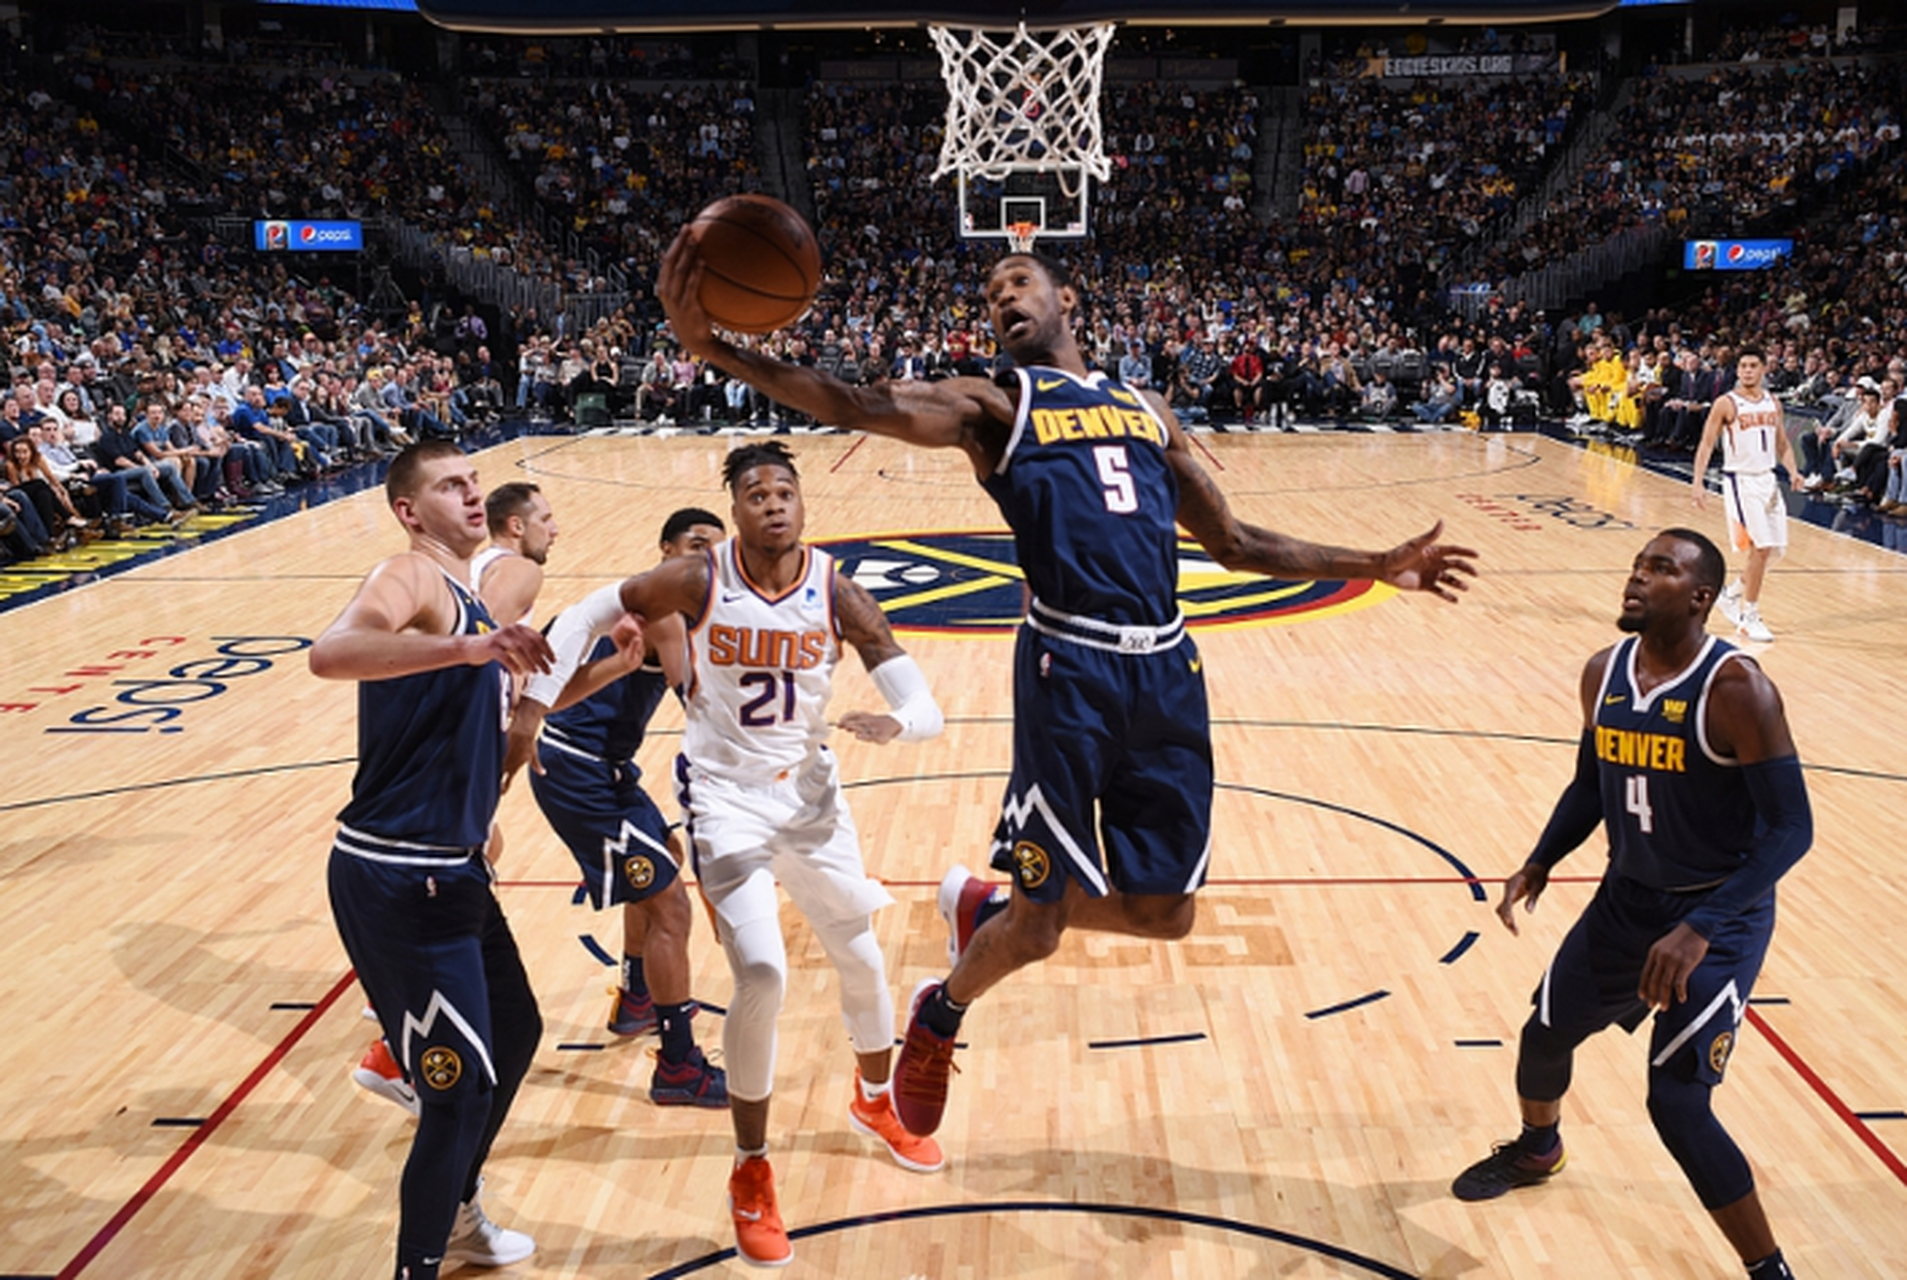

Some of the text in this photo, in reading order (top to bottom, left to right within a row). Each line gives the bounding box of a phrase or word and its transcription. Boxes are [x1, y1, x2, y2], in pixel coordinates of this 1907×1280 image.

[1031, 404, 1164, 446] DENVER
[1761, 429, 1767, 452] 1
[1093, 445, 1138, 514] 5
[709, 624, 827, 670] SUNS
[44, 635, 314, 735] pepsi
[739, 671, 797, 727] 21
[1596, 725, 1686, 773] DENVER
[1626, 774, 1652, 833] 4
